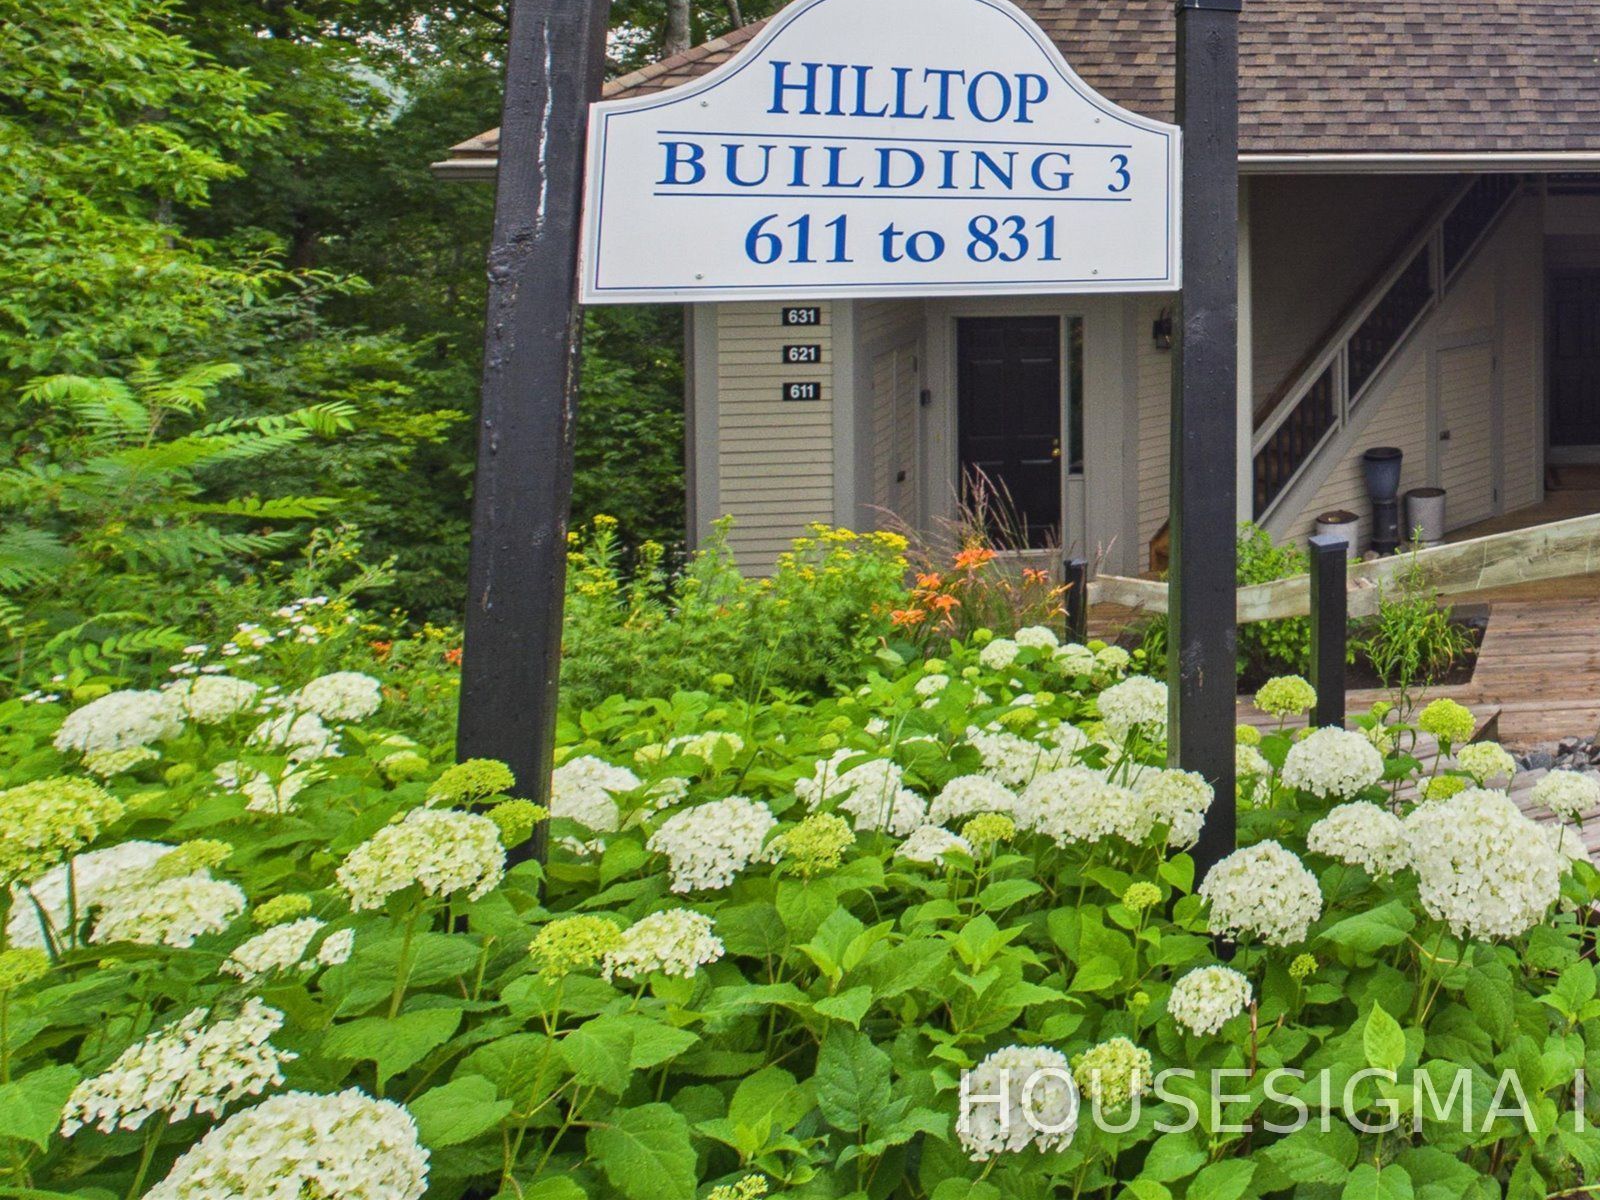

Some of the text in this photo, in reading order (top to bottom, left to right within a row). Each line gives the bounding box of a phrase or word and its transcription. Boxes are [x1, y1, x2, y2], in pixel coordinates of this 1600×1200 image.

[767, 60, 1049, 124] HILLTOP
[655, 141, 1132, 193] BUILDING 3
[744, 213, 1062, 265] 611 to 831
[788, 309, 816, 324] 631
[788, 346, 816, 361] 621
[790, 384, 815, 399] 611
